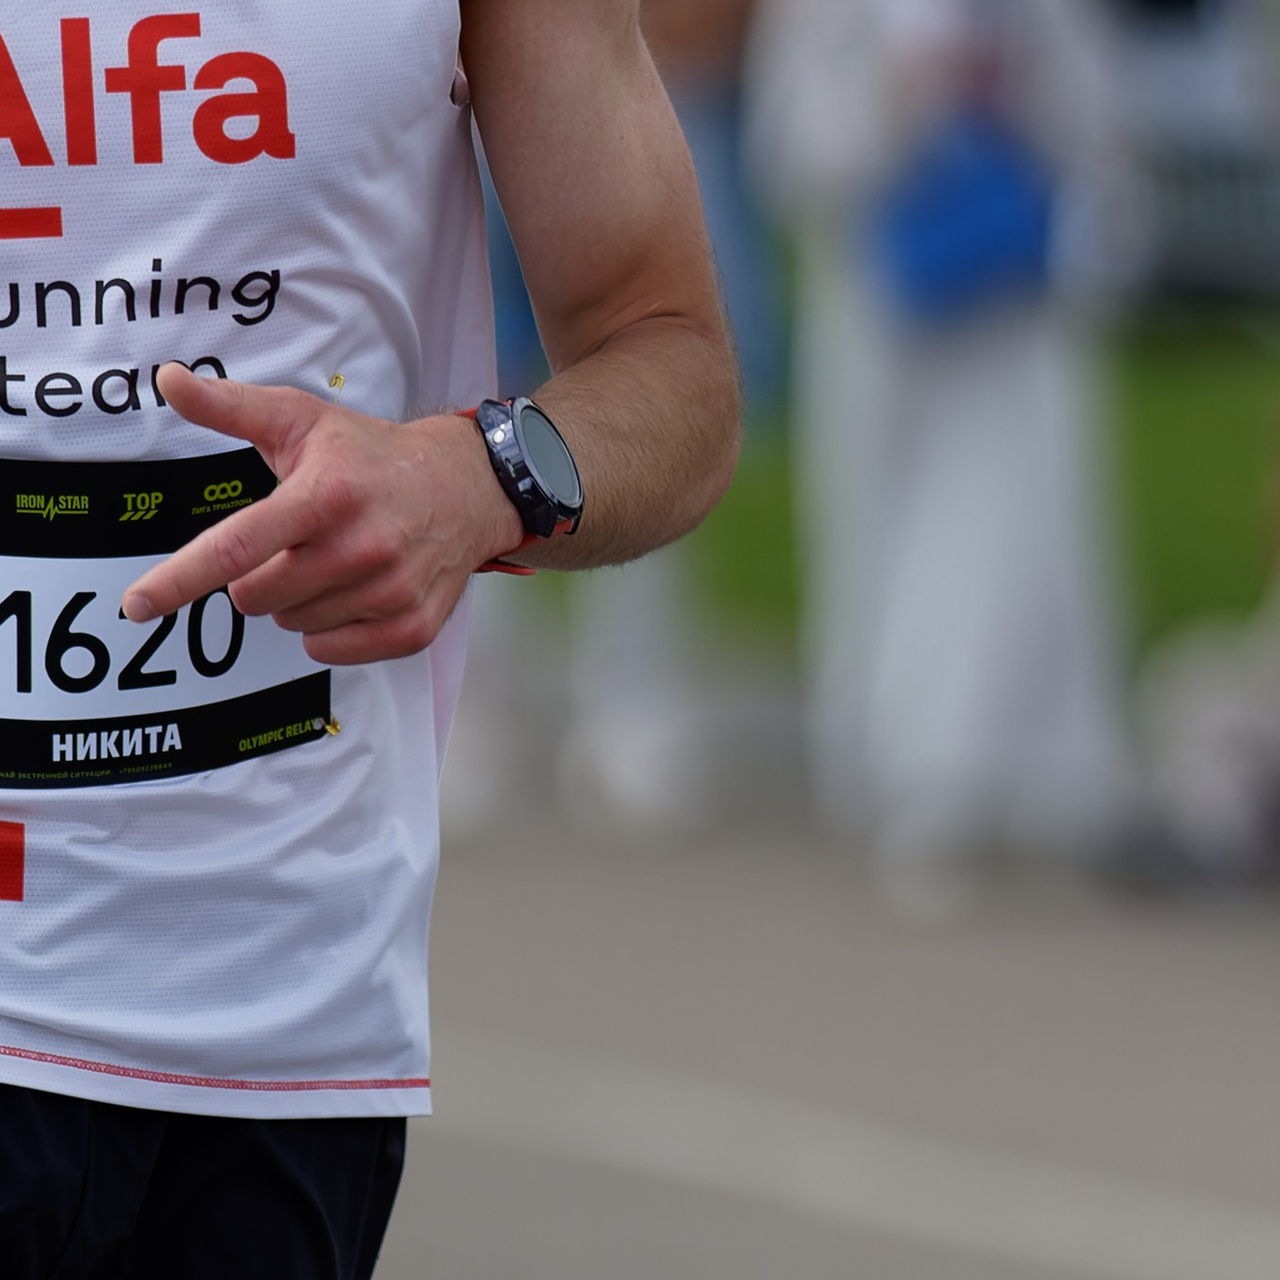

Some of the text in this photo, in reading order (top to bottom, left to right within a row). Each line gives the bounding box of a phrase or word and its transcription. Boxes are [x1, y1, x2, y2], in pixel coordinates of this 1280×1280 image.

[123, 491, 164, 511] TOP
[51, 722, 183, 762] НИКИТА
[238, 727, 285, 753] OLYMPIC
